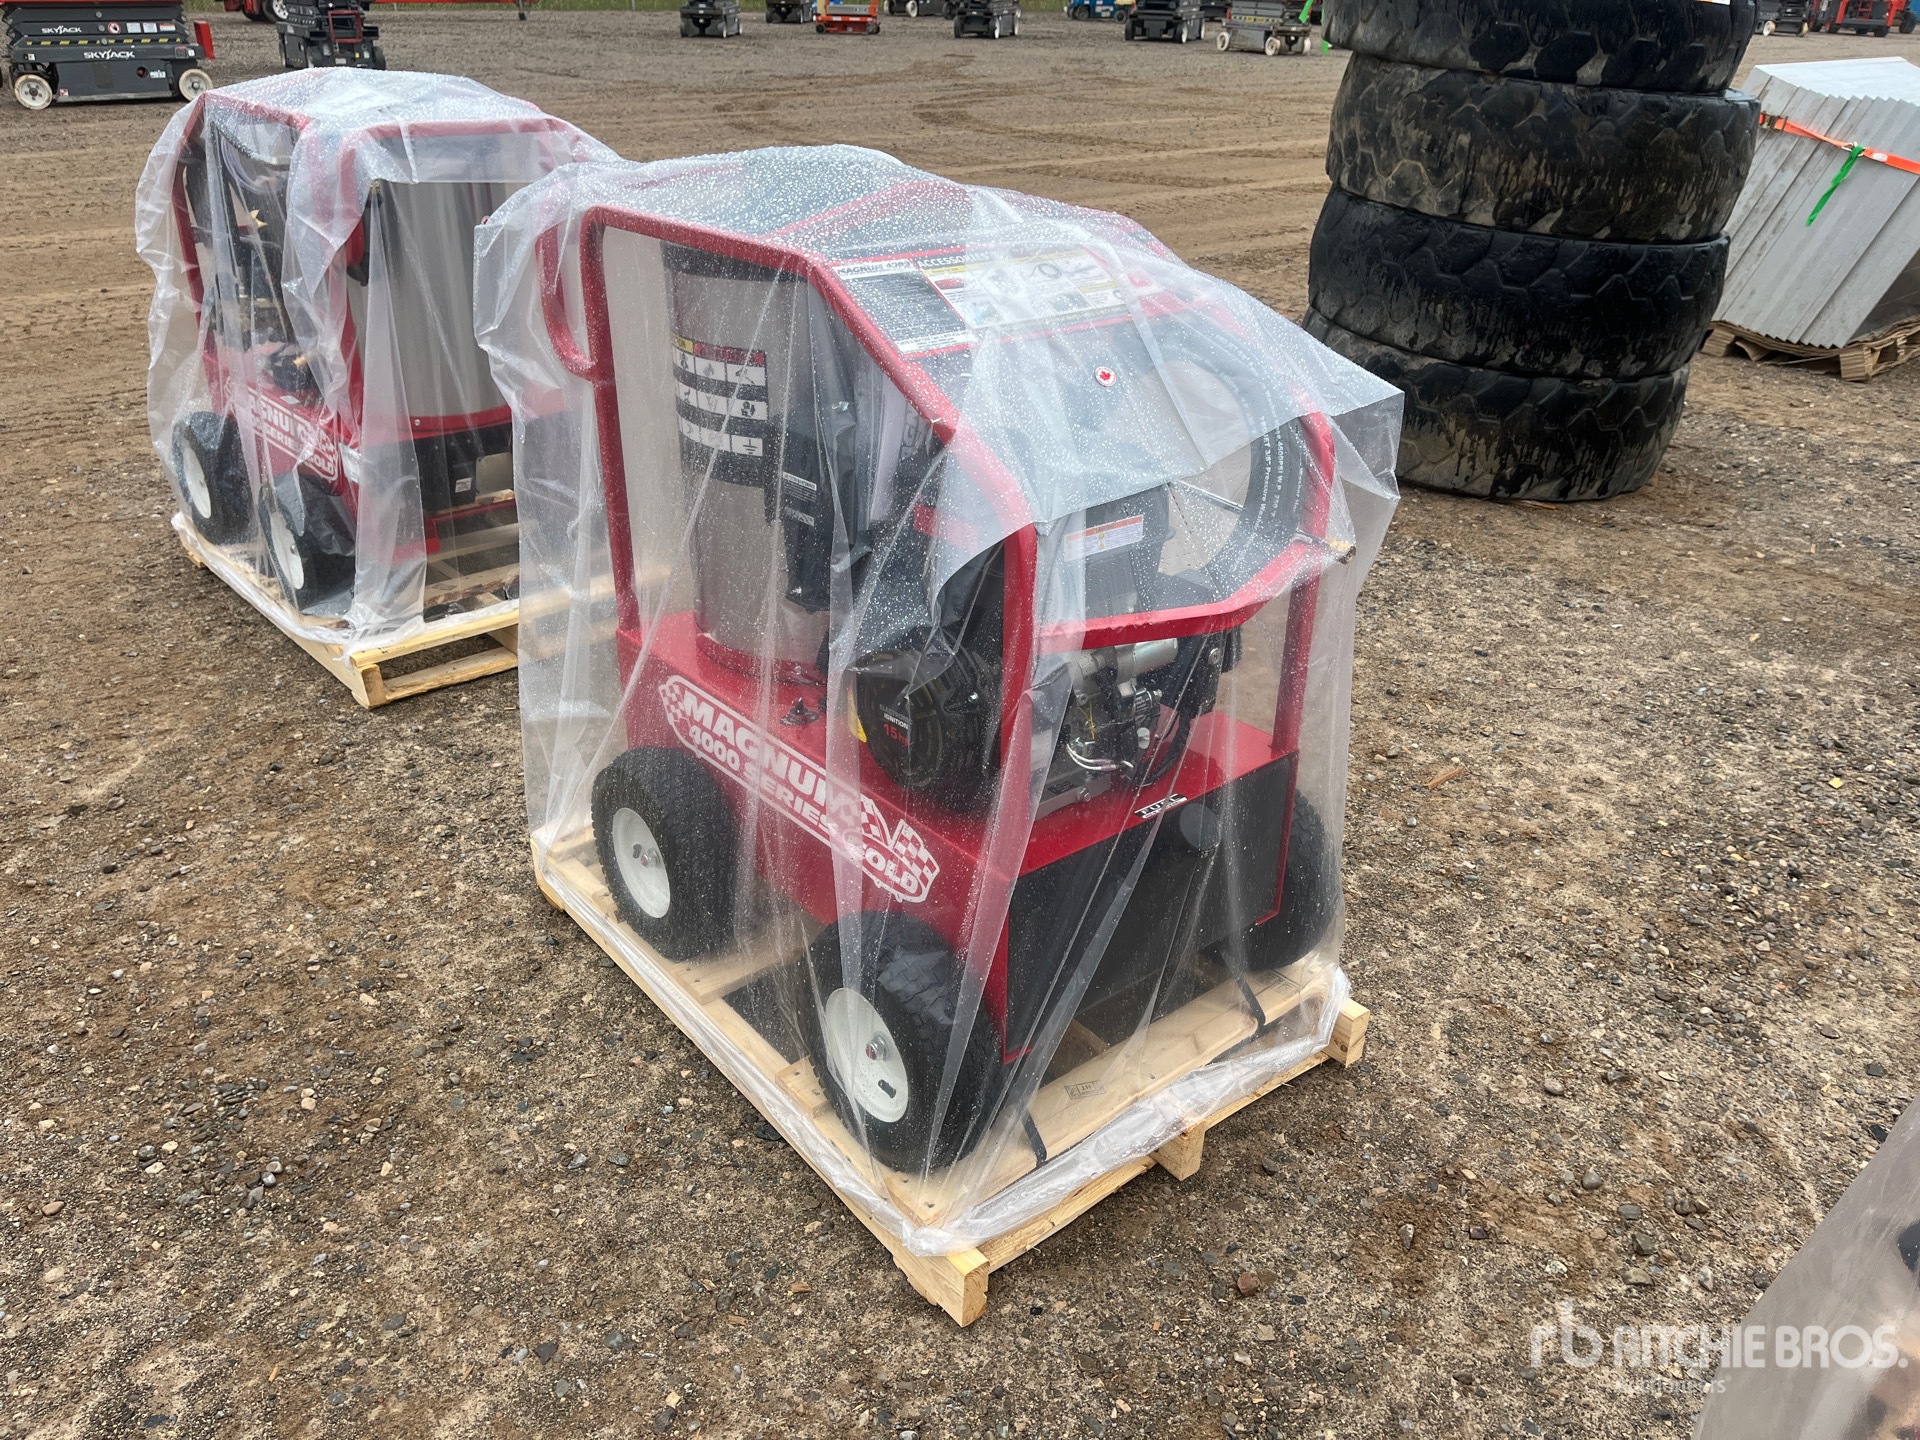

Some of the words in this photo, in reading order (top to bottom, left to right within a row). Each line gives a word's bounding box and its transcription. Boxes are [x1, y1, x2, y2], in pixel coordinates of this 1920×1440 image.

[41, 25, 82, 34] SKYJACK
[83, 49, 135, 60] SKYJACK
[917, 252, 990, 270] ACCESSORIES
[1261, 467, 1271, 501] Pressure
[884, 712, 909, 730] IGNITION
[682, 690, 846, 816] MAGNUM
[688, 724, 741, 772] 4000
[742, 760, 833, 829] SERIES
